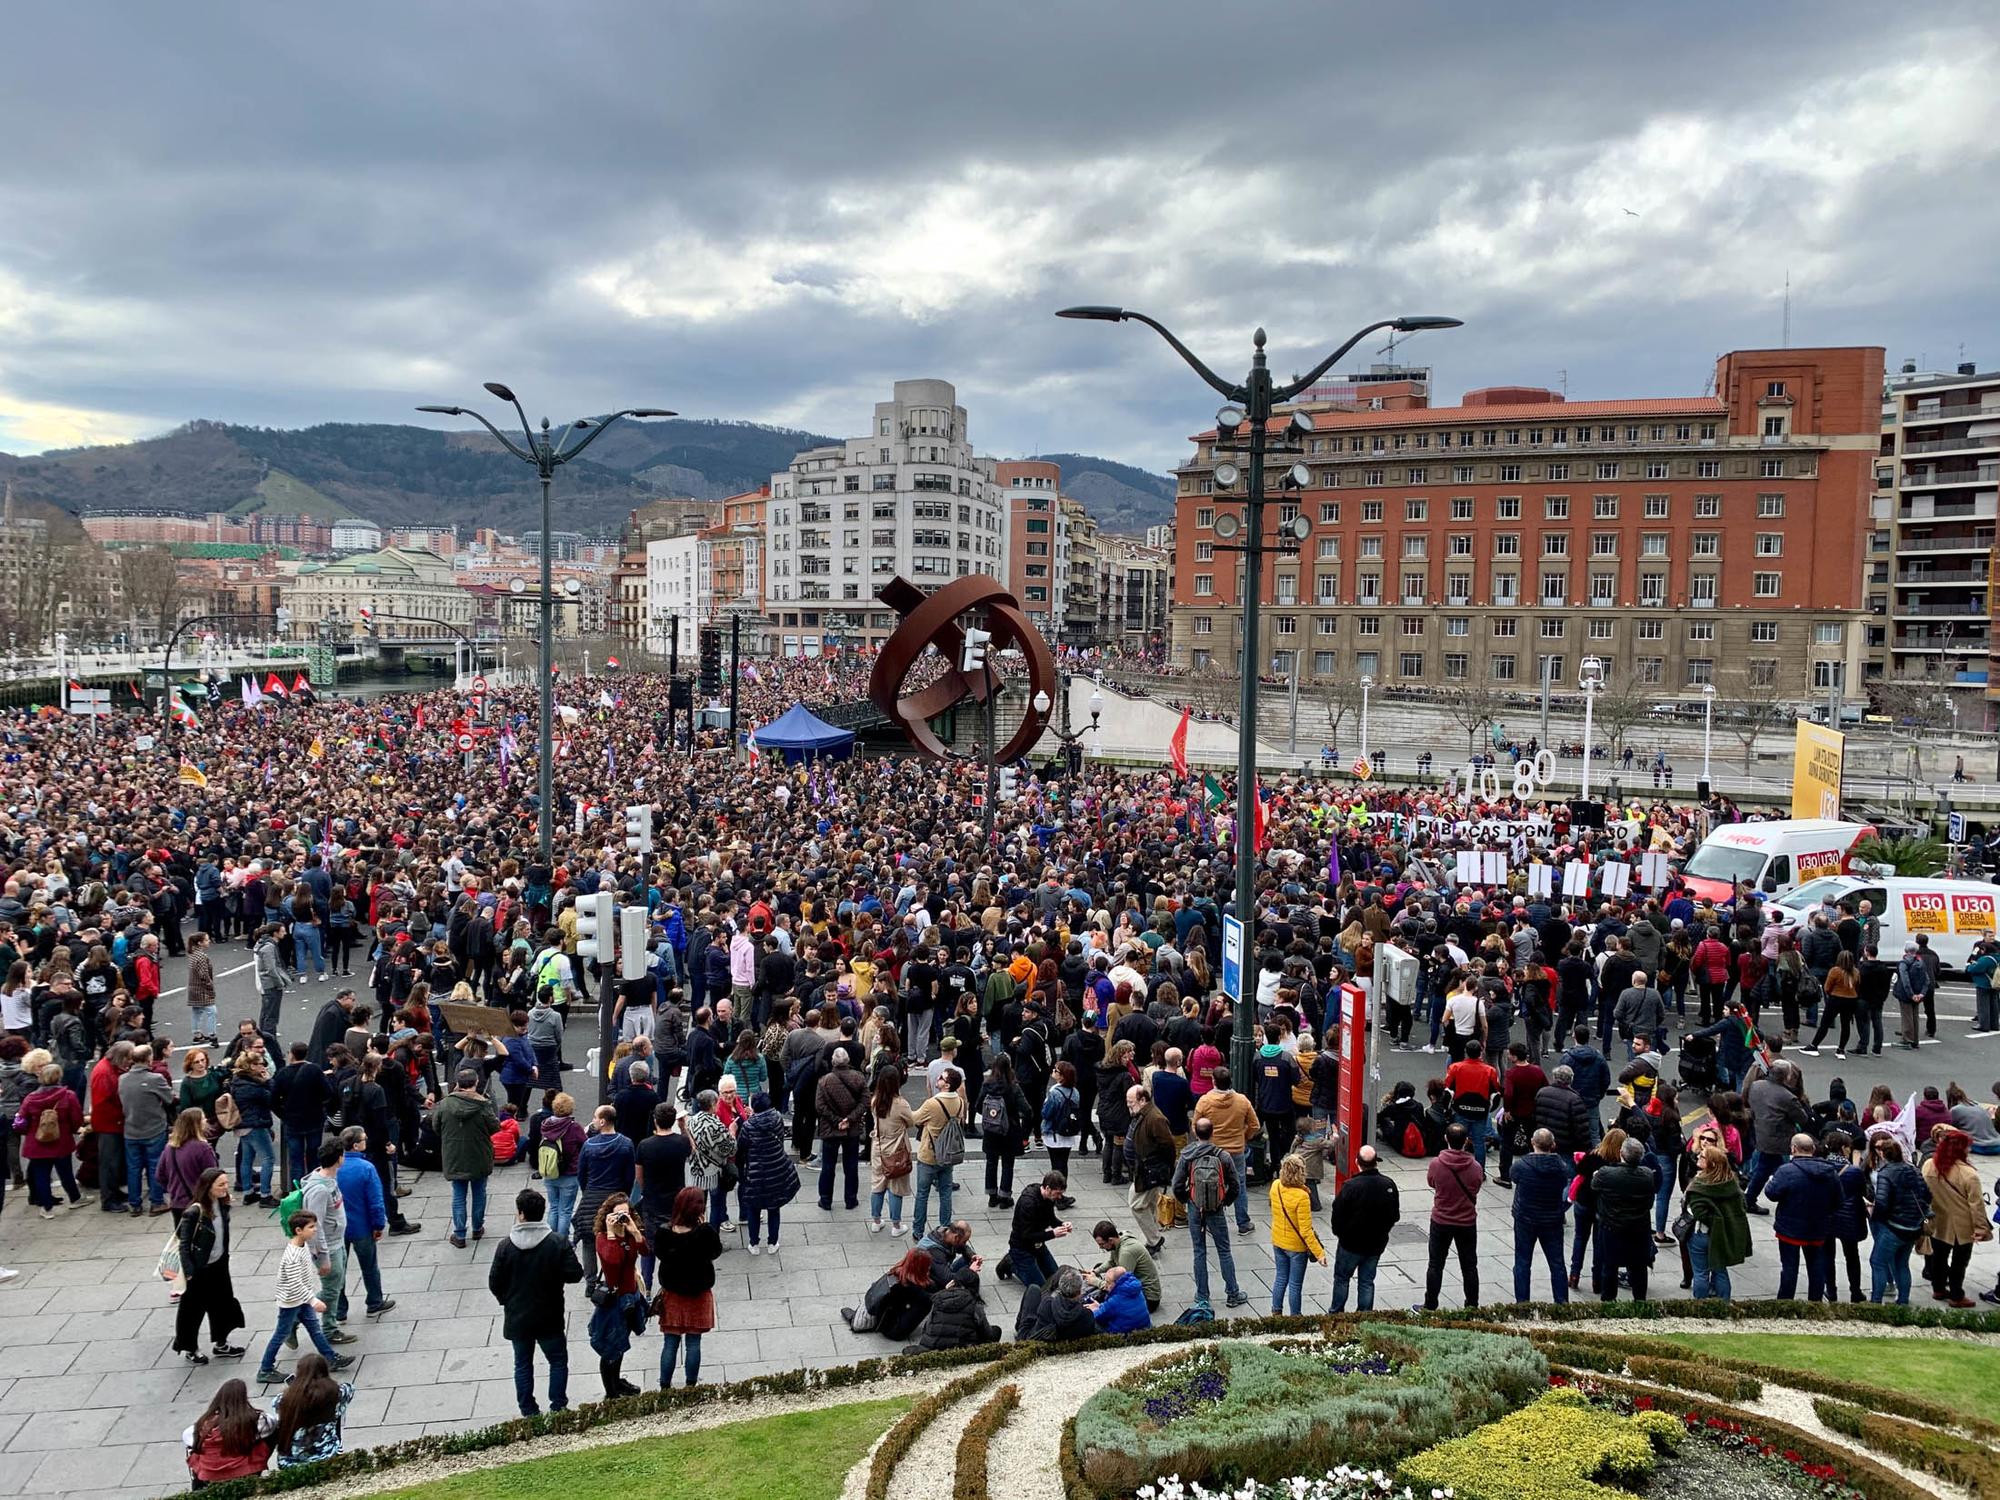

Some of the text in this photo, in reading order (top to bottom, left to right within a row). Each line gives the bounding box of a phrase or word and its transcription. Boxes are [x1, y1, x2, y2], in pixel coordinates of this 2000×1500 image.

[1908, 896, 1943, 911] U30
[1956, 898, 1991, 912] U30
[1911, 911, 1937, 919] GREBA
[1959, 913, 1985, 921] GREBA
